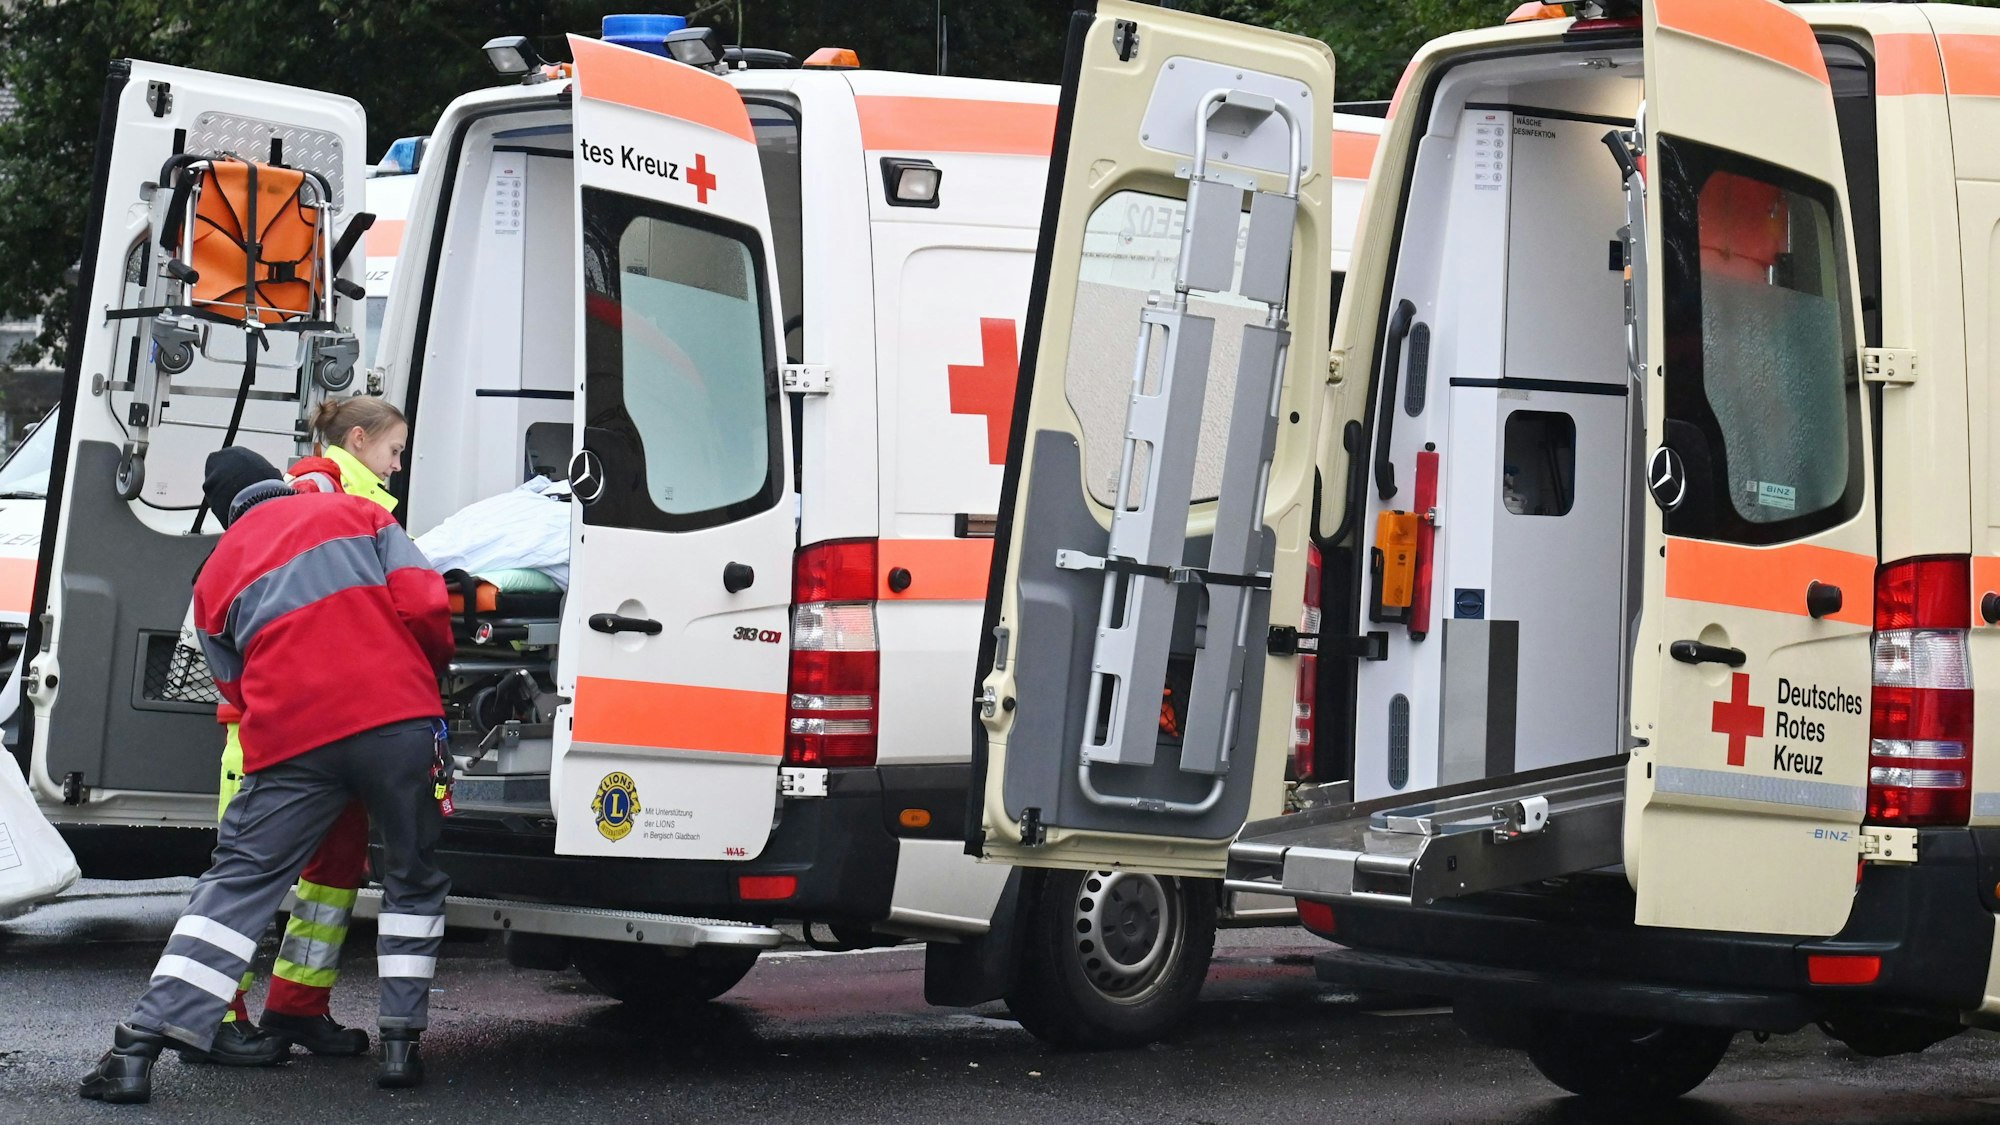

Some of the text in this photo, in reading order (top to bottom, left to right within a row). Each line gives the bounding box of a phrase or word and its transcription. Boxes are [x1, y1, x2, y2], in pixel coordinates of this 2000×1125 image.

[1516, 117, 1542, 127] WÄSCHE
[1513, 128, 1556, 139] DESINFEKTION
[581, 139, 679, 181] tes Kreuz
[1766, 485, 1790, 495] BINZ
[733, 626, 782, 644] 313 CDI
[1777, 677, 1862, 715] Deutsches
[1776, 711, 1825, 743] Rotes
[1773, 744, 1823, 776] Kreuz
[604, 775, 633, 790] LIONS
[610, 794, 623, 817] L
[645, 807, 693, 818] Mit Unterstützung
[644, 820, 675, 829] der LIONS
[650, 831, 674, 841] Bergisch
[675, 832, 700, 841] Gladbach
[1814, 828, 1848, 842] BINZ
